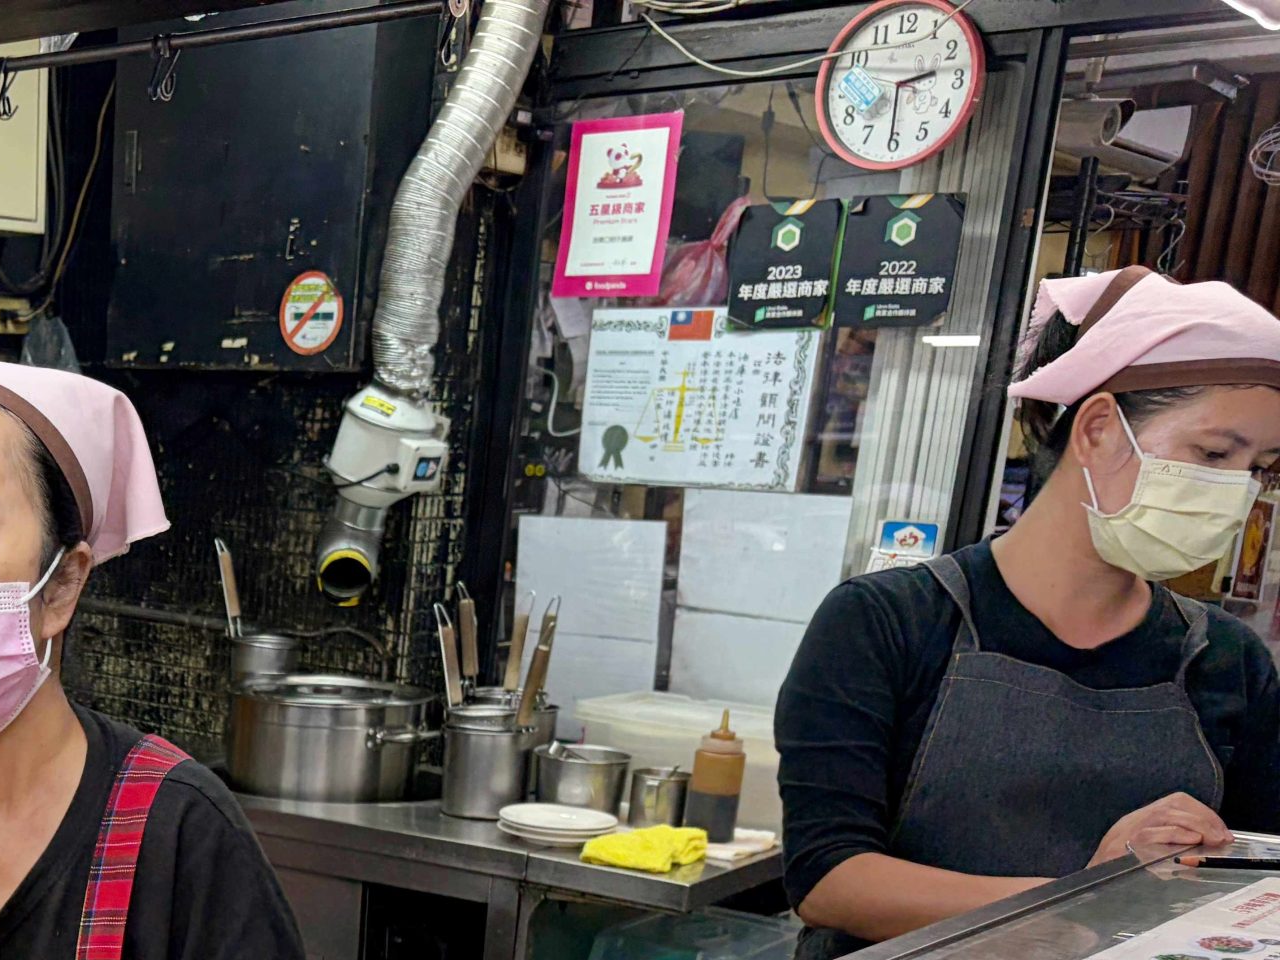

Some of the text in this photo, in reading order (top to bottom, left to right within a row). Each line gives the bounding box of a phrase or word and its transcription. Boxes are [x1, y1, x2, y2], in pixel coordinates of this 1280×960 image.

[896, 12, 918, 35] 12
[929, 19, 939, 40] 1
[872, 24, 889, 46] 11
[944, 39, 958, 61] 2
[951, 68, 965, 90] 3
[843, 105, 855, 126] 8
[939, 98, 951, 118] 4
[862, 125, 874, 145] 7
[887, 131, 900, 152] 6
[915, 121, 929, 141] 5
[589, 201, 645, 216] 五星級商家
[766, 264, 802, 281] 2023
[878, 260, 917, 276] 2022
[737, 279, 830, 301] 年度嚴選商家
[844, 276, 947, 296] 年度嚴選商家
